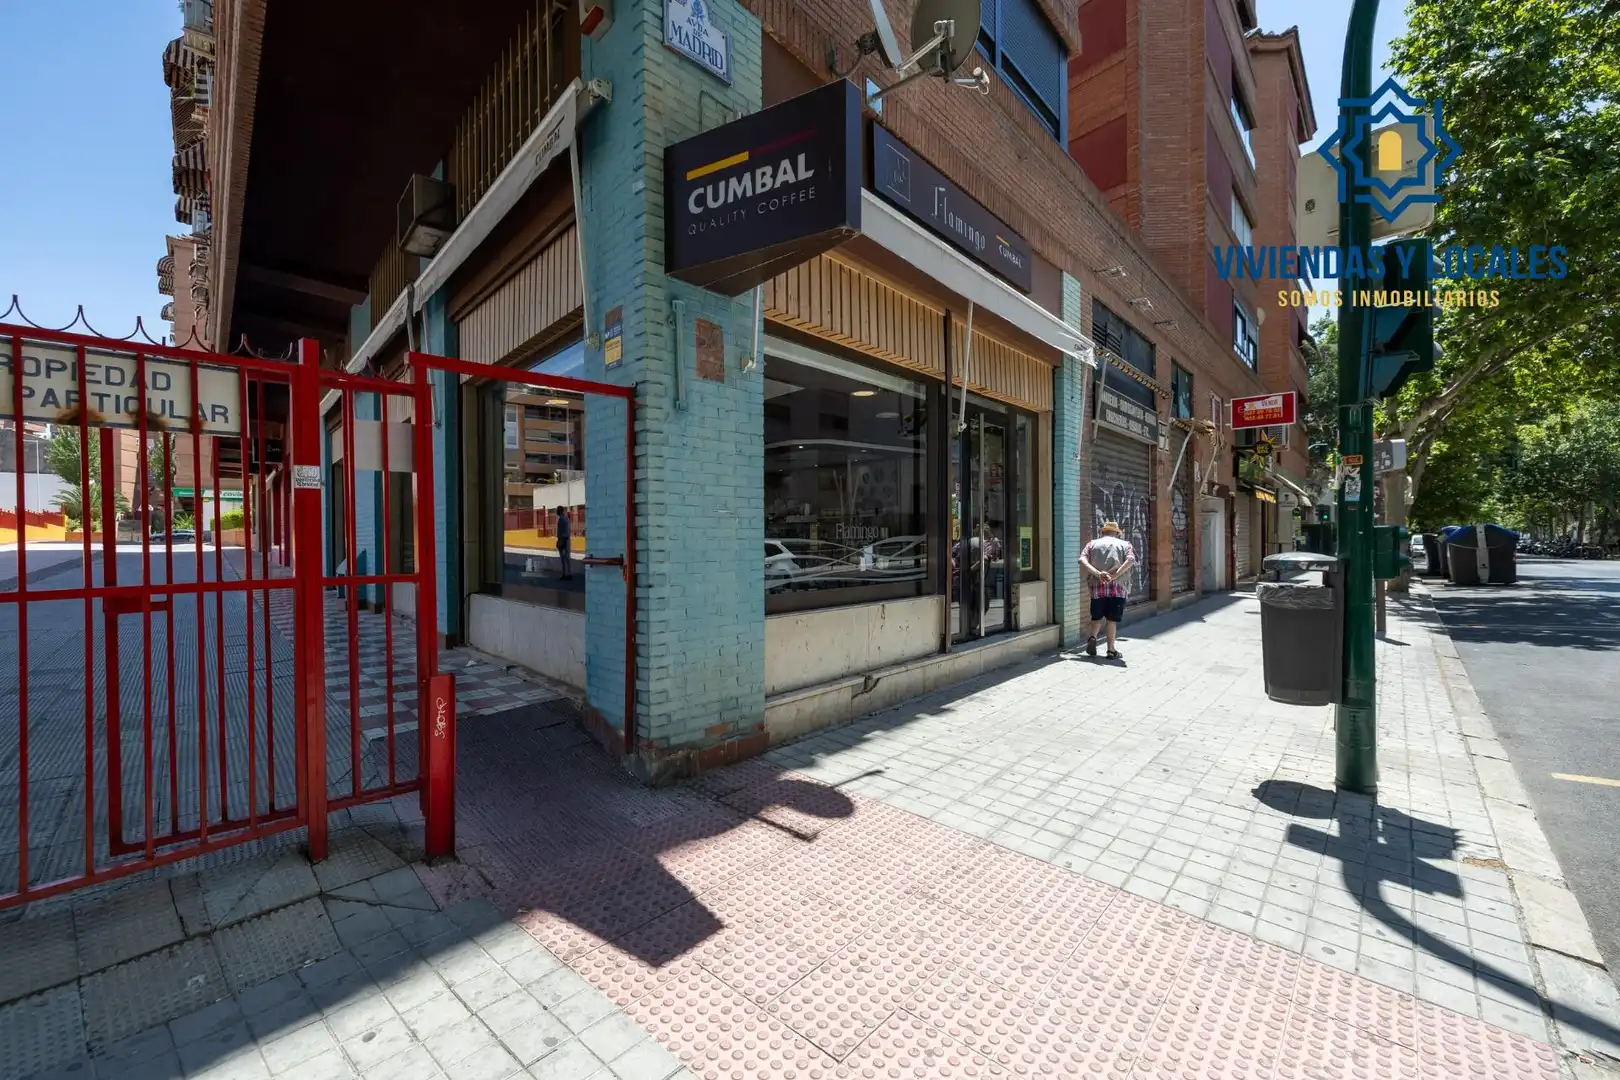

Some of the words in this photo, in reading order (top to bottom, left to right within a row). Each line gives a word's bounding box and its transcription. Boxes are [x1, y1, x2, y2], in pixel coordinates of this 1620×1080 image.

[668, 20, 724, 70] MADRID
[688, 152, 815, 214] CUMBAL
[688, 209, 747, 236] QUALITY
[757, 186, 816, 214] COFFEE
[931, 186, 986, 251] Flamingo
[998, 244, 1022, 269] CUMBAL
[835, 521, 879, 543] Flamingo
